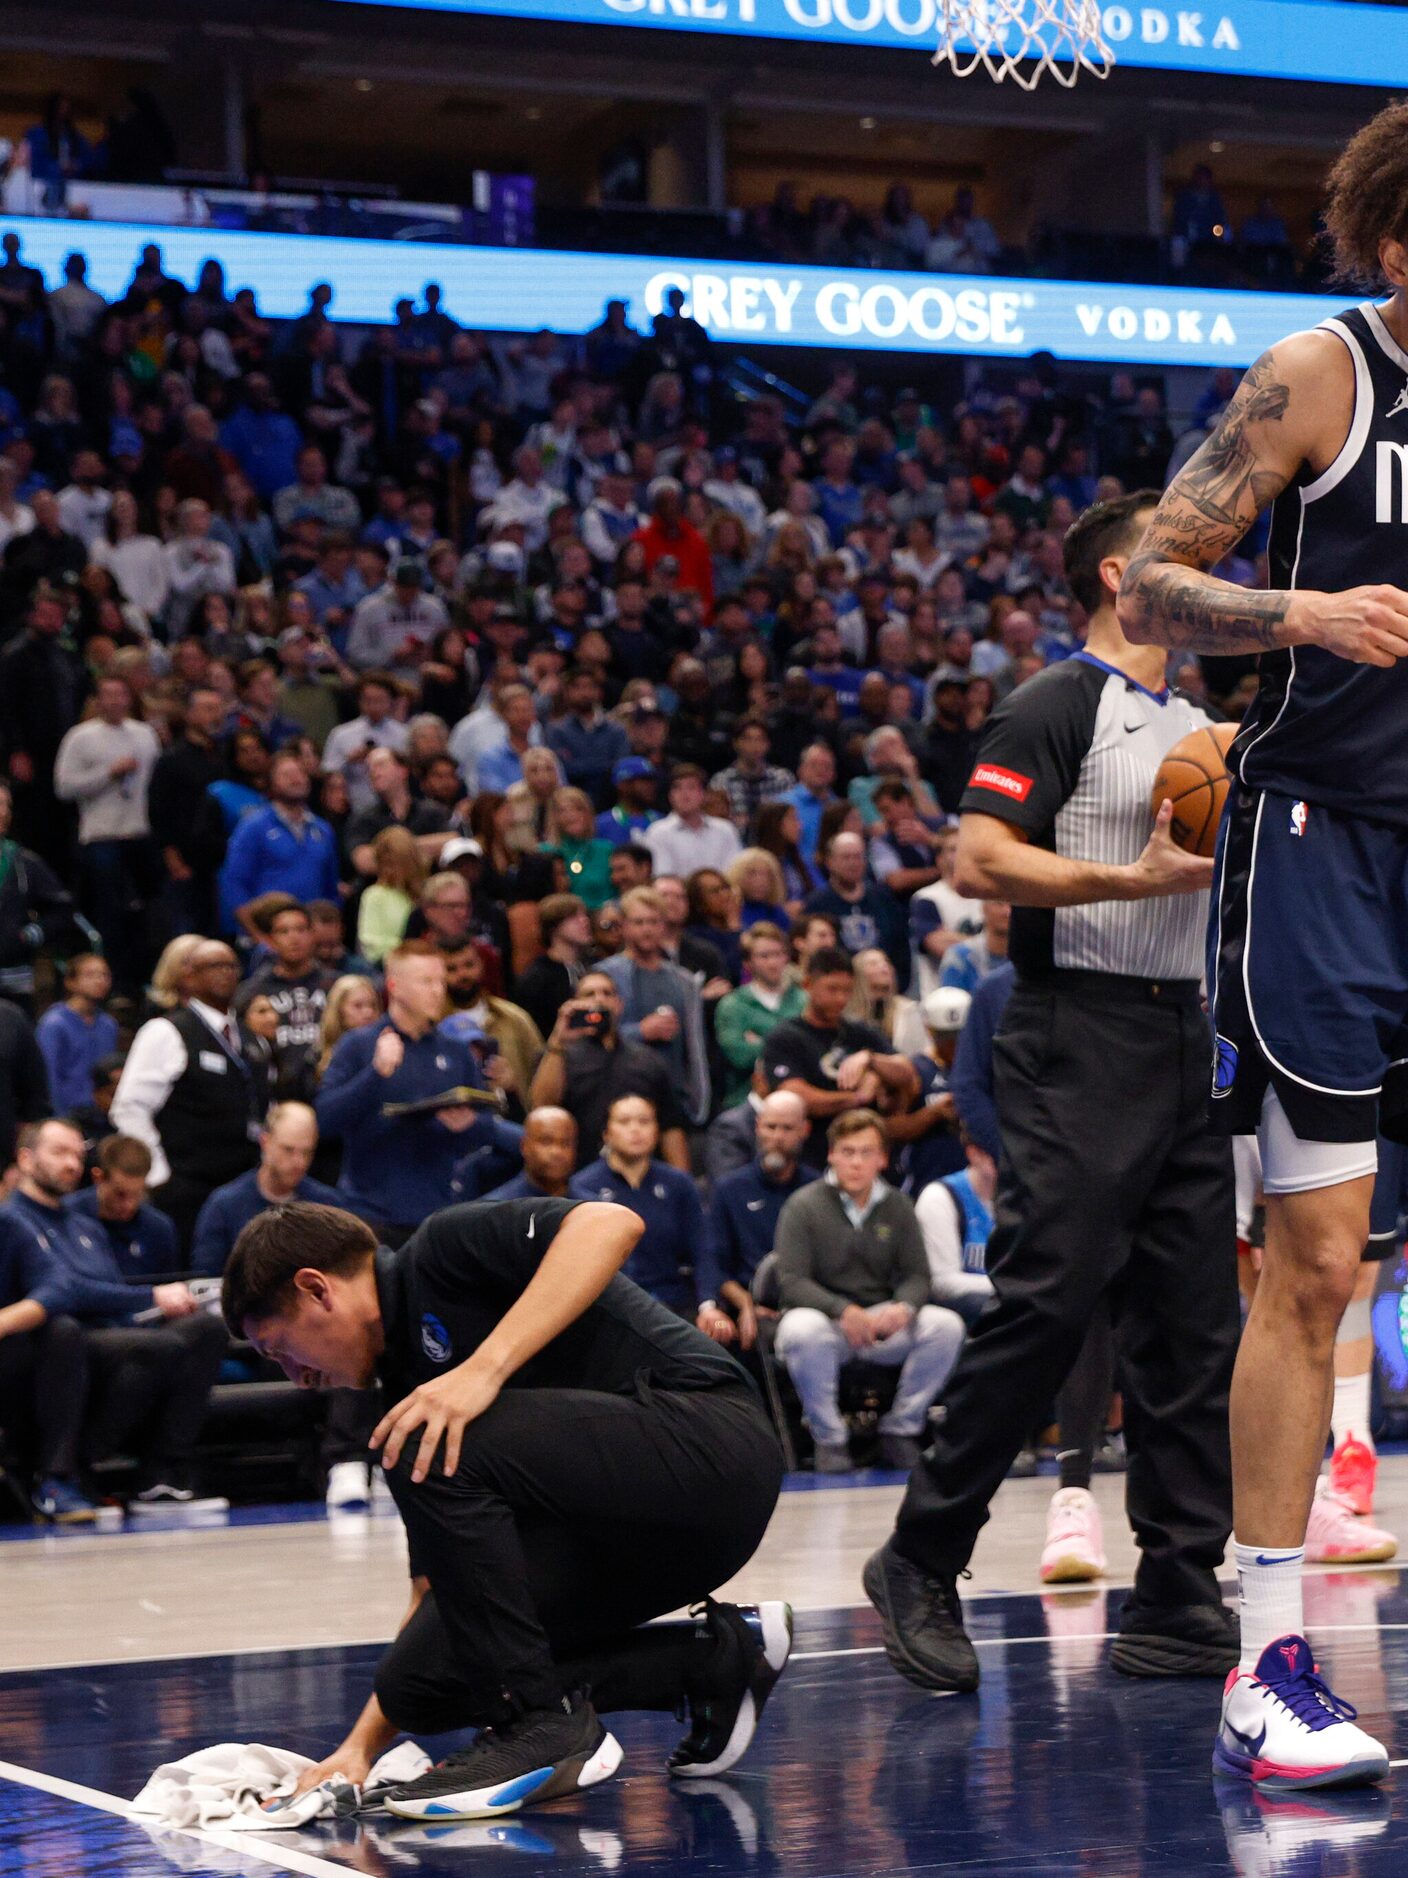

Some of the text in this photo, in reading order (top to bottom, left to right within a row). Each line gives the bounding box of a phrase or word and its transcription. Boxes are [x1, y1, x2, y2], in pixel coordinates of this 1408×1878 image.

[815, 282, 1024, 344] GOOSE
[1075, 303, 1237, 346] VODKA
[974, 768, 1024, 794] Emirates
